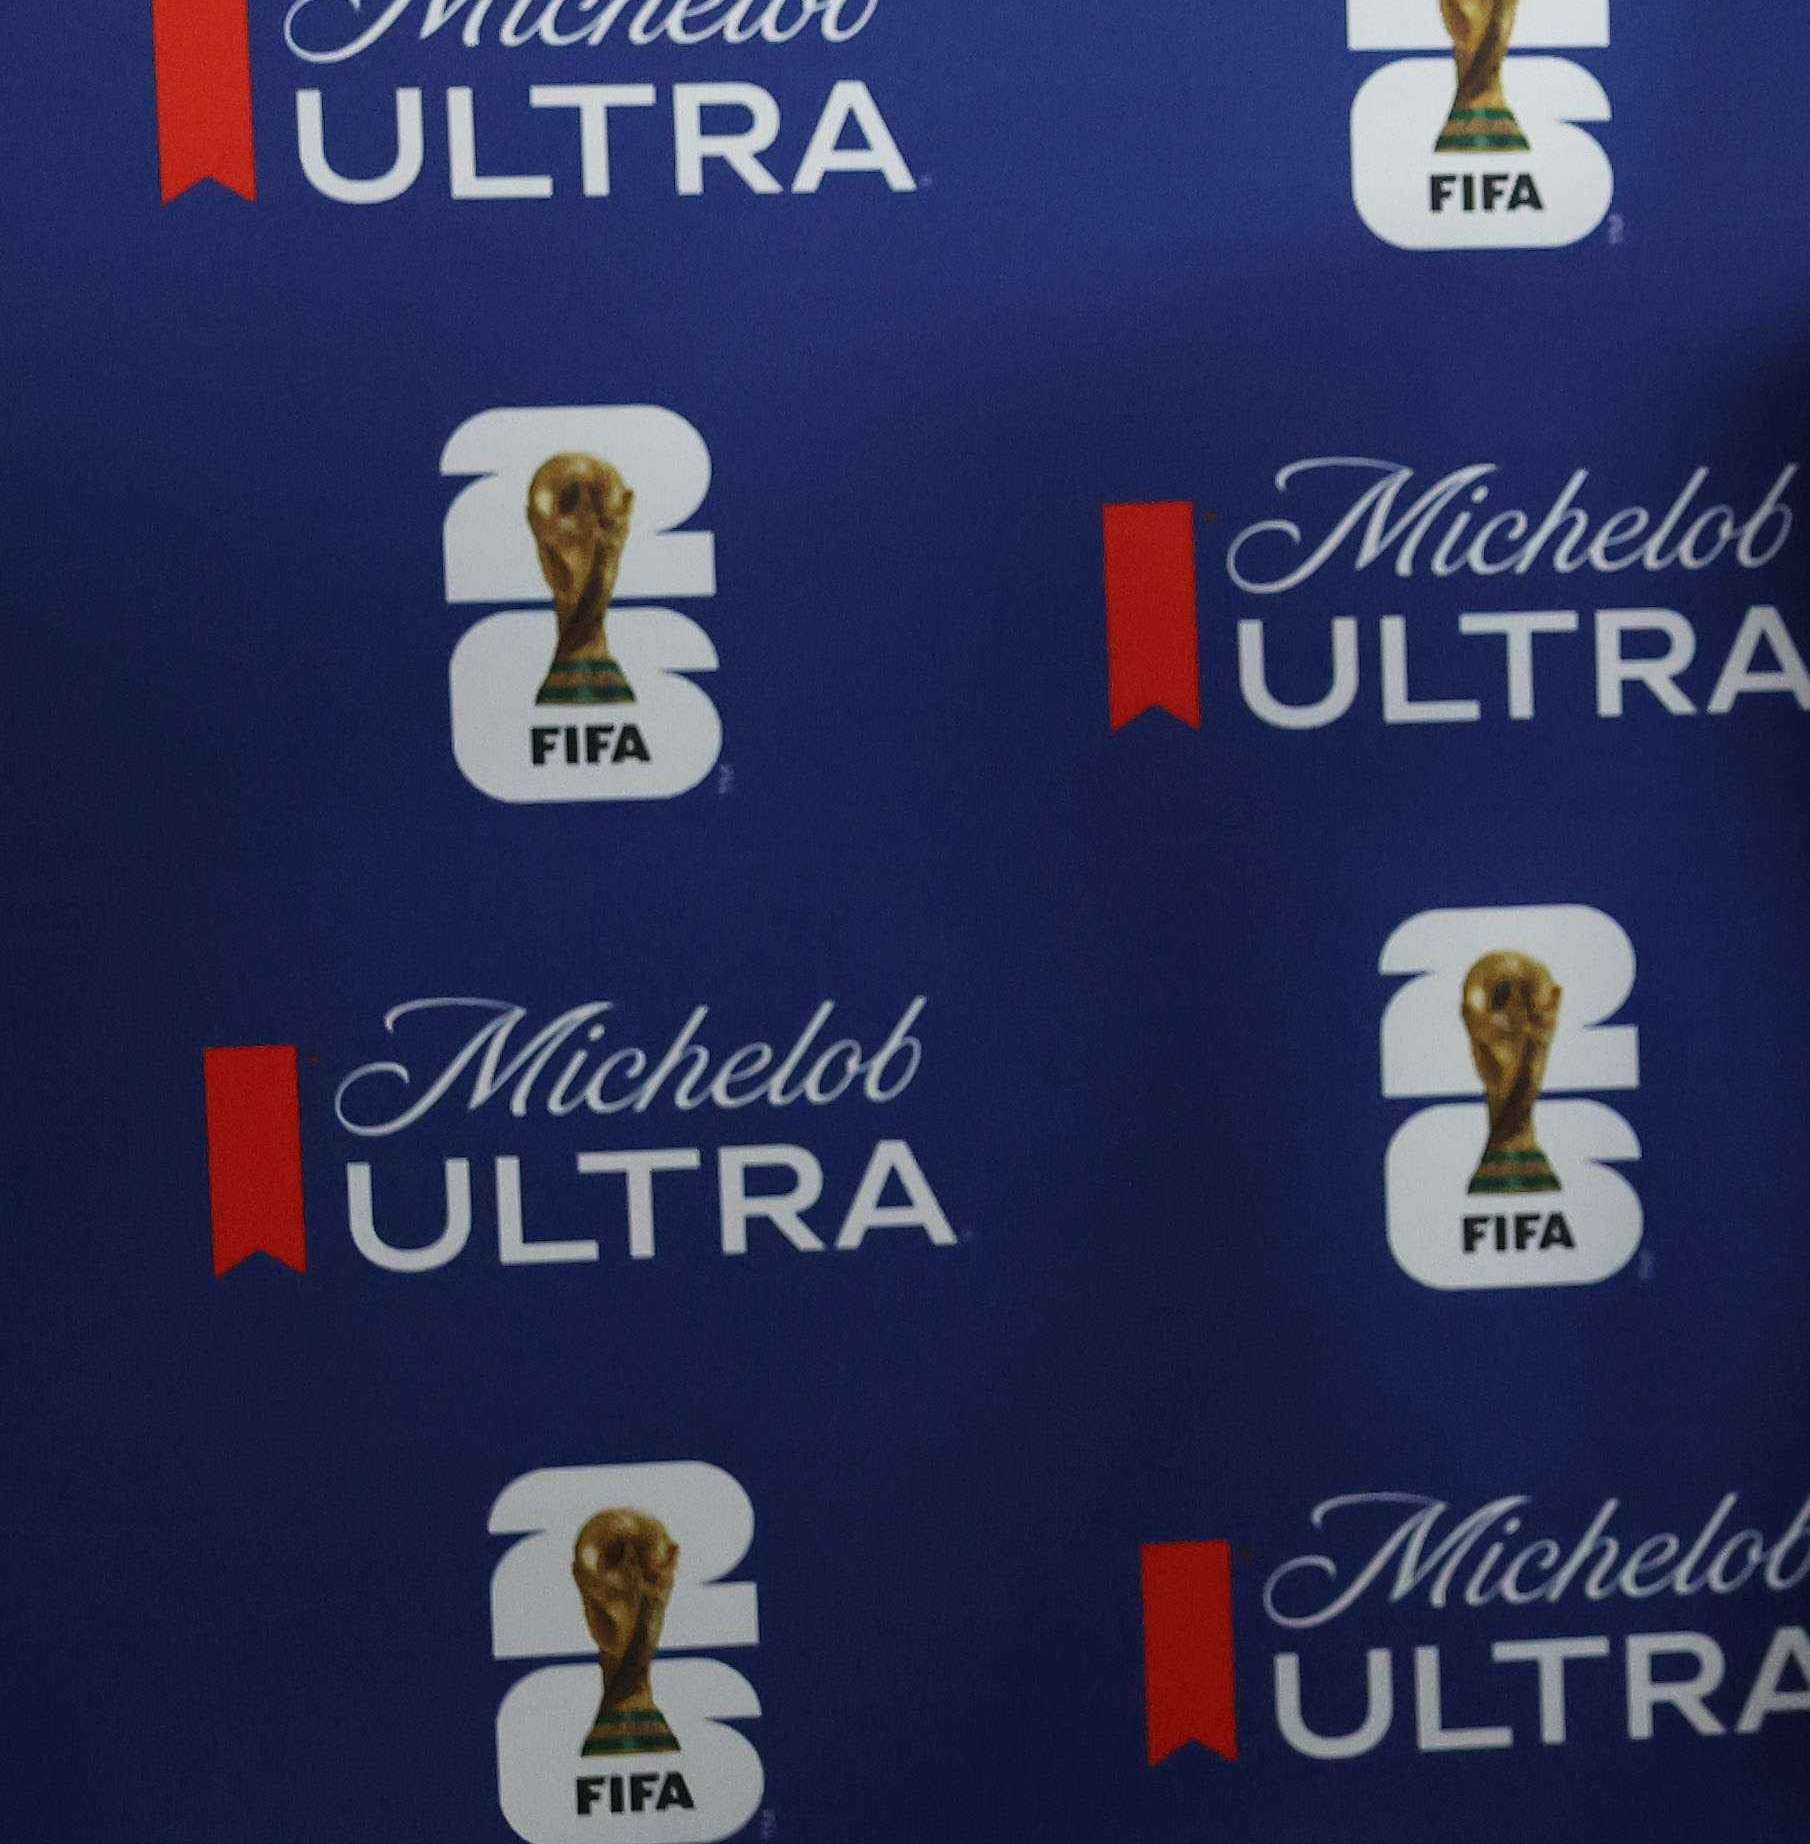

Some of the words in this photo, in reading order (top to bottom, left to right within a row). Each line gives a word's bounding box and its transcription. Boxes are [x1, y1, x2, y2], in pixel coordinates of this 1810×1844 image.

[294, 78, 918, 206] ULTRA
[1429, 172, 1544, 214] FIFA
[1225, 455, 1797, 595] Michelob
[529, 723, 652, 767] FIFA
[333, 994, 928, 1138] Michelob
[345, 1138, 959, 1274] ULTRA
[1462, 1211, 1576, 1254] FIFA
[575, 1770, 696, 1816] FIFA
